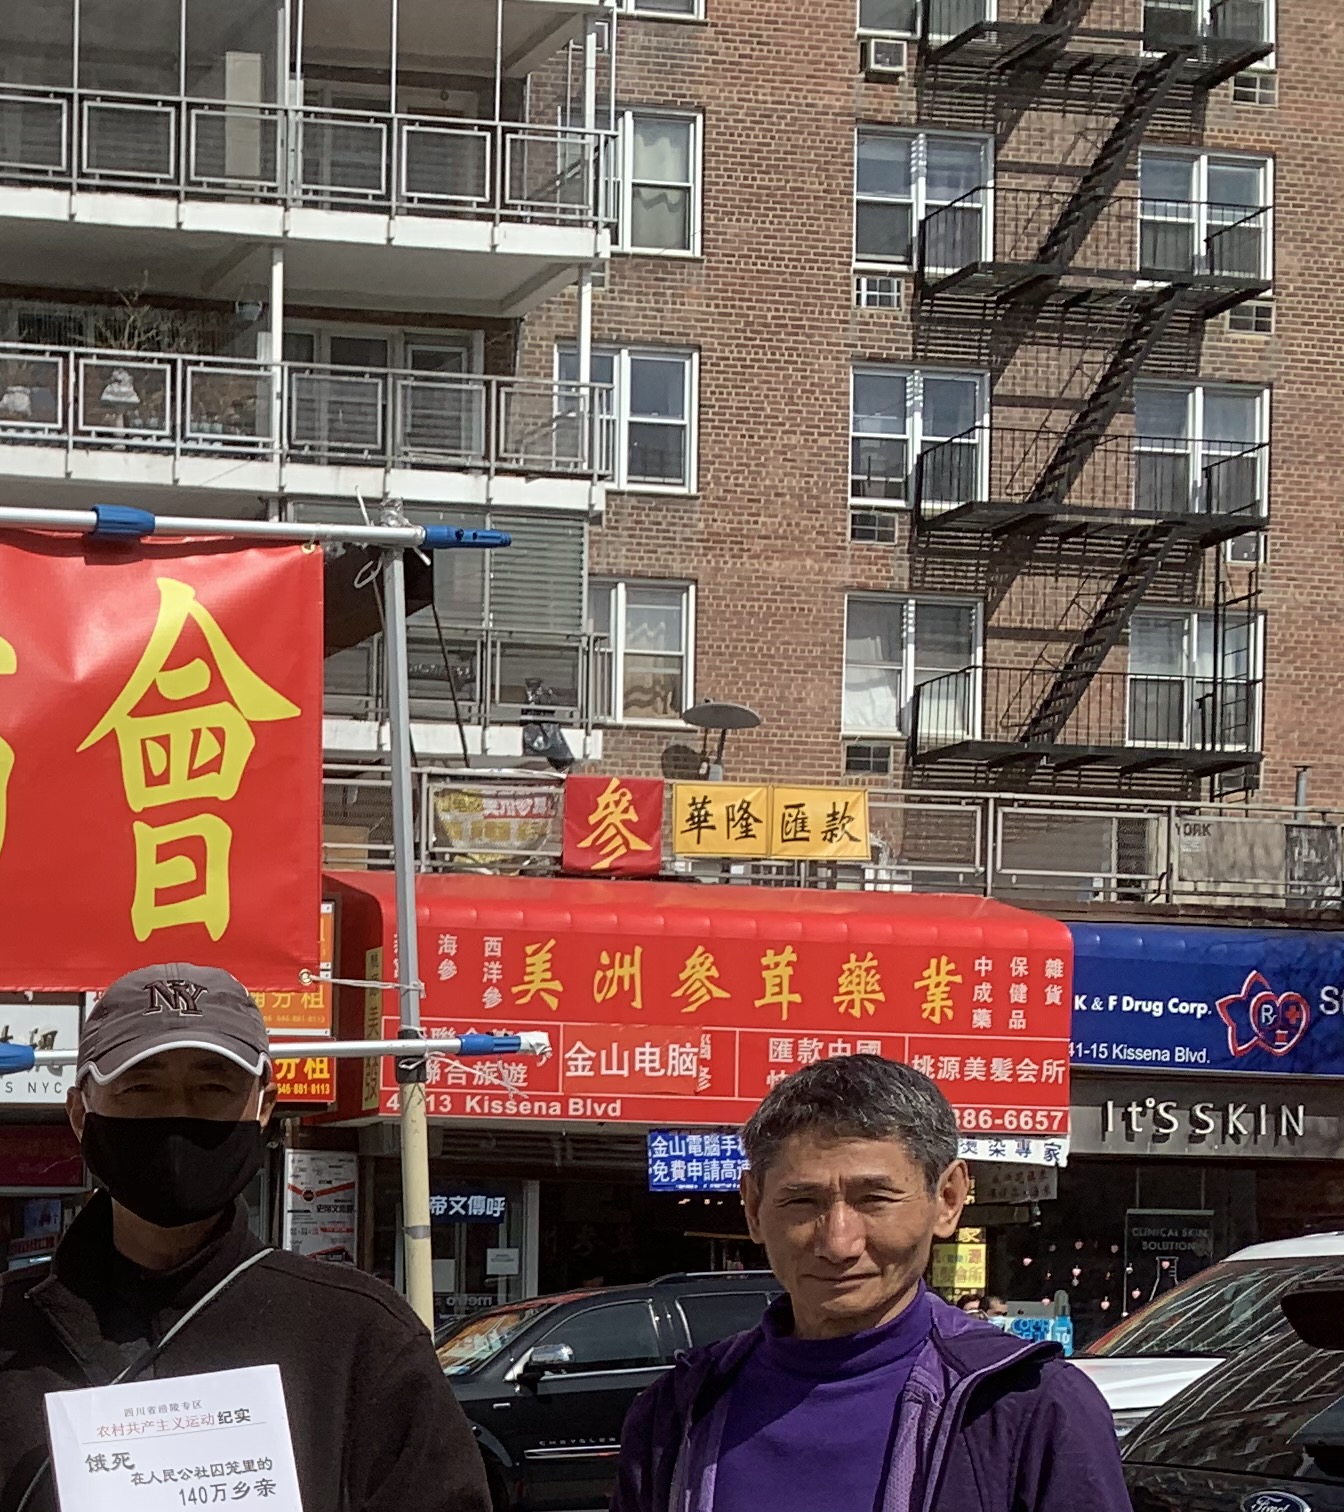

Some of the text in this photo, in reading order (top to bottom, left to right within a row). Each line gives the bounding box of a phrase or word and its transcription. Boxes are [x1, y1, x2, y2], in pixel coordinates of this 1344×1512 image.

[482, 936, 504, 1010] 西洋參
[142, 979, 208, 1017] NY
[1008, 956, 1029, 1030] 保健品
[1074, 995, 1212, 1019] K & F Drug Corp.
[565, 1041, 699, 1078] 金山电脑
[1112, 1044, 1170, 1062] Kissena
[1175, 1047, 1211, 1064] Blvd.
[27, 1082, 63, 1094] NYC
[466, 1095, 622, 1117] Kissena Blvd
[1195, 1103, 1305, 1137] SKIN
